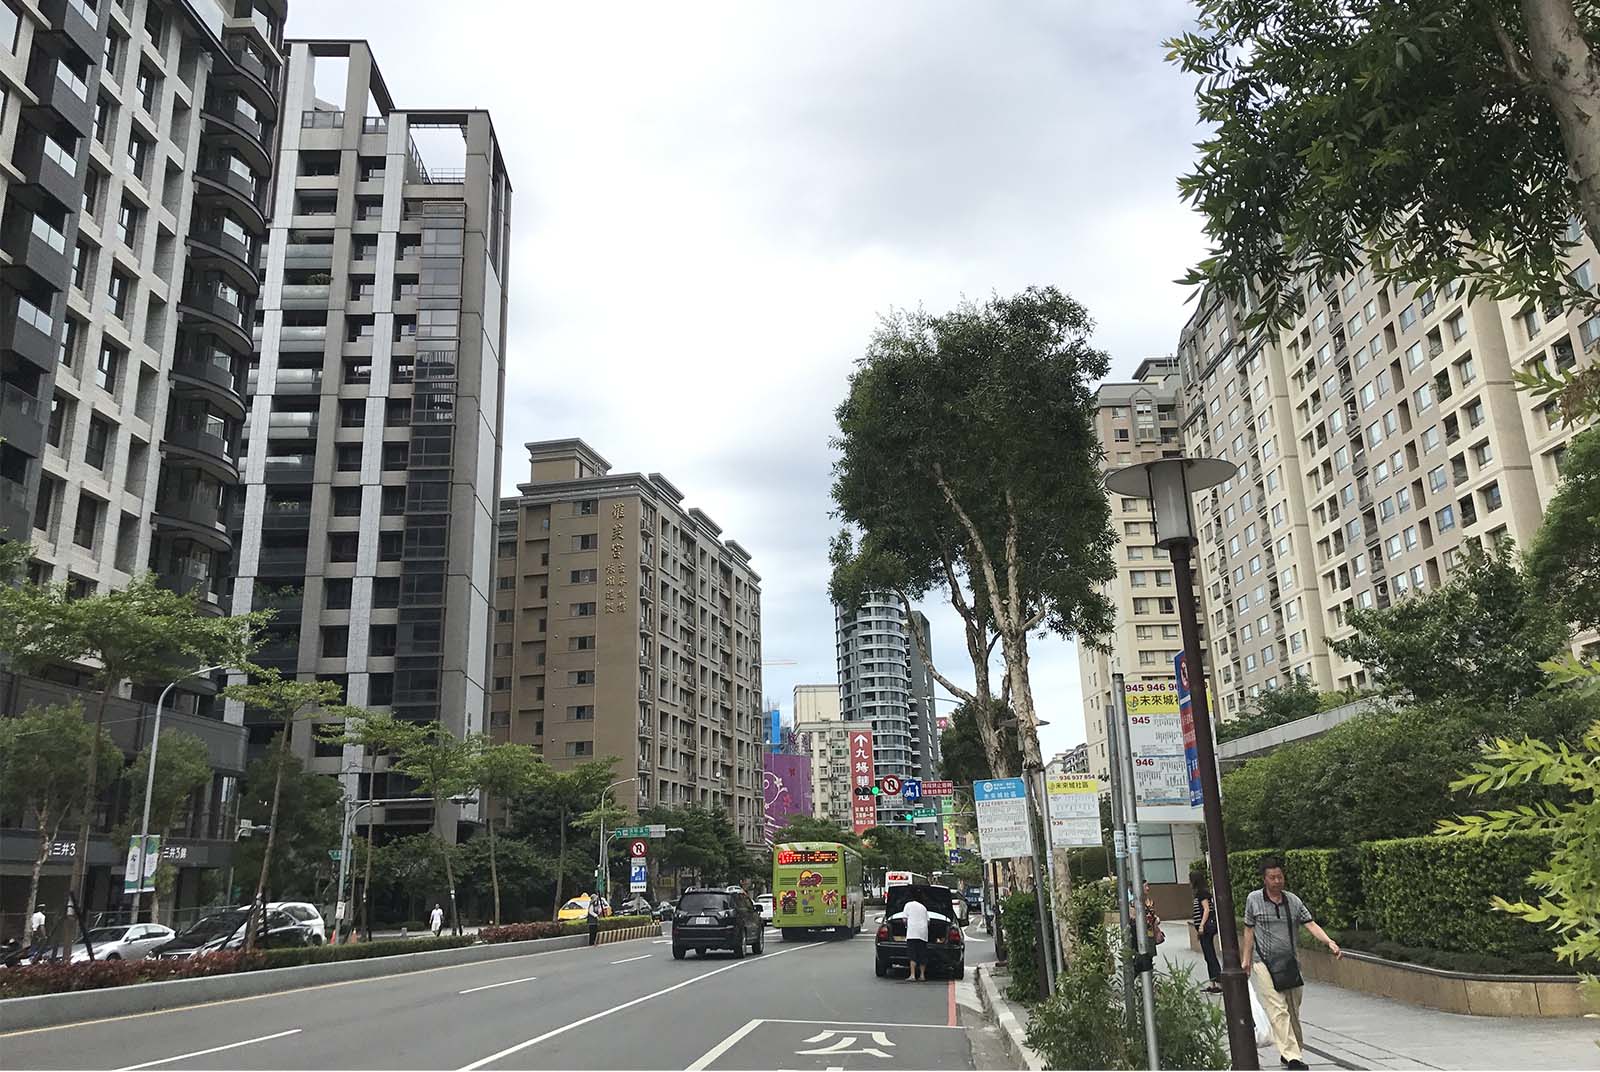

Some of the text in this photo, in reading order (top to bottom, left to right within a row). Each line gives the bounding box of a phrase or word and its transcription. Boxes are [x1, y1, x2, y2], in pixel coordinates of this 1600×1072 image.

[1125, 684, 1144, 692] 945
[1146, 683, 1166, 692] 946
[631, 866, 640, 877] P
